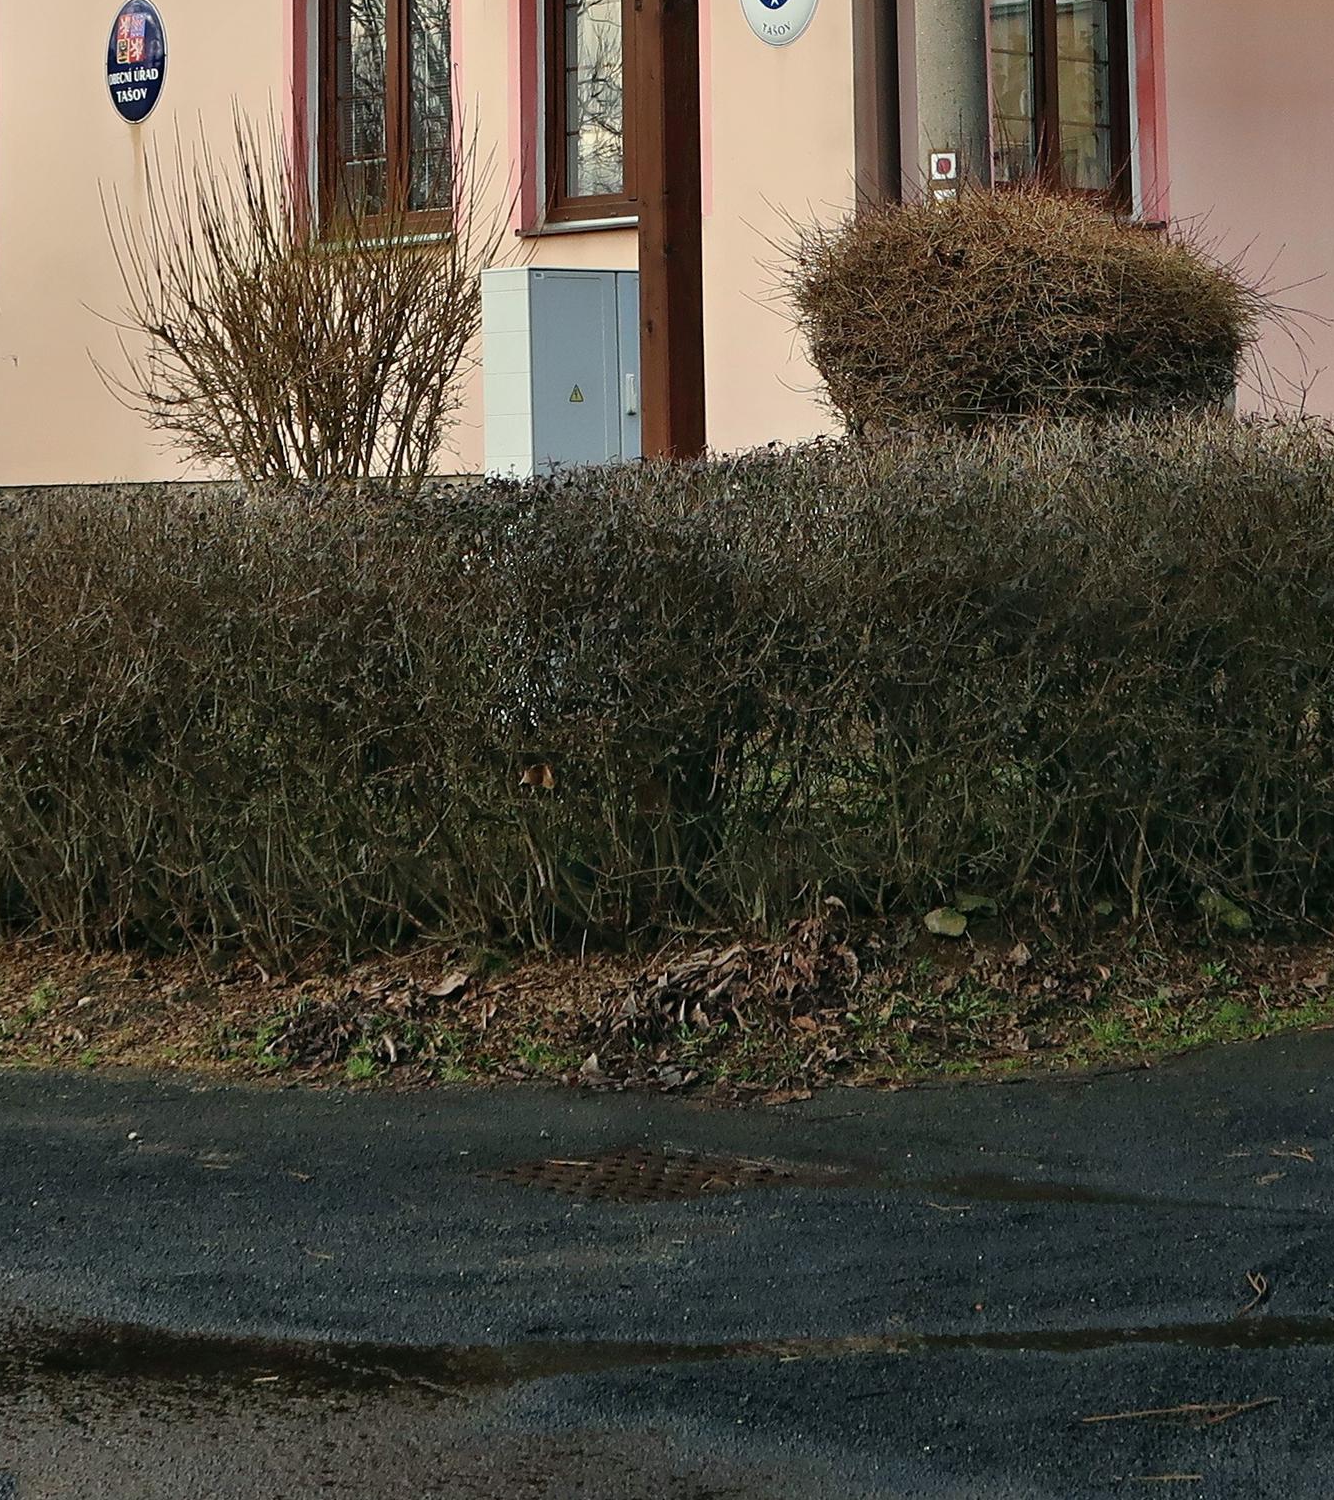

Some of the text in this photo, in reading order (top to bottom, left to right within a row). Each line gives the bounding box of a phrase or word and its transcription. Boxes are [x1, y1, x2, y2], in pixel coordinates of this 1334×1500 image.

[761, 22, 792, 37] TAŠOV
[133, 66, 159, 82] ÚŘAD
[116, 87, 148, 103] TAŠOV
